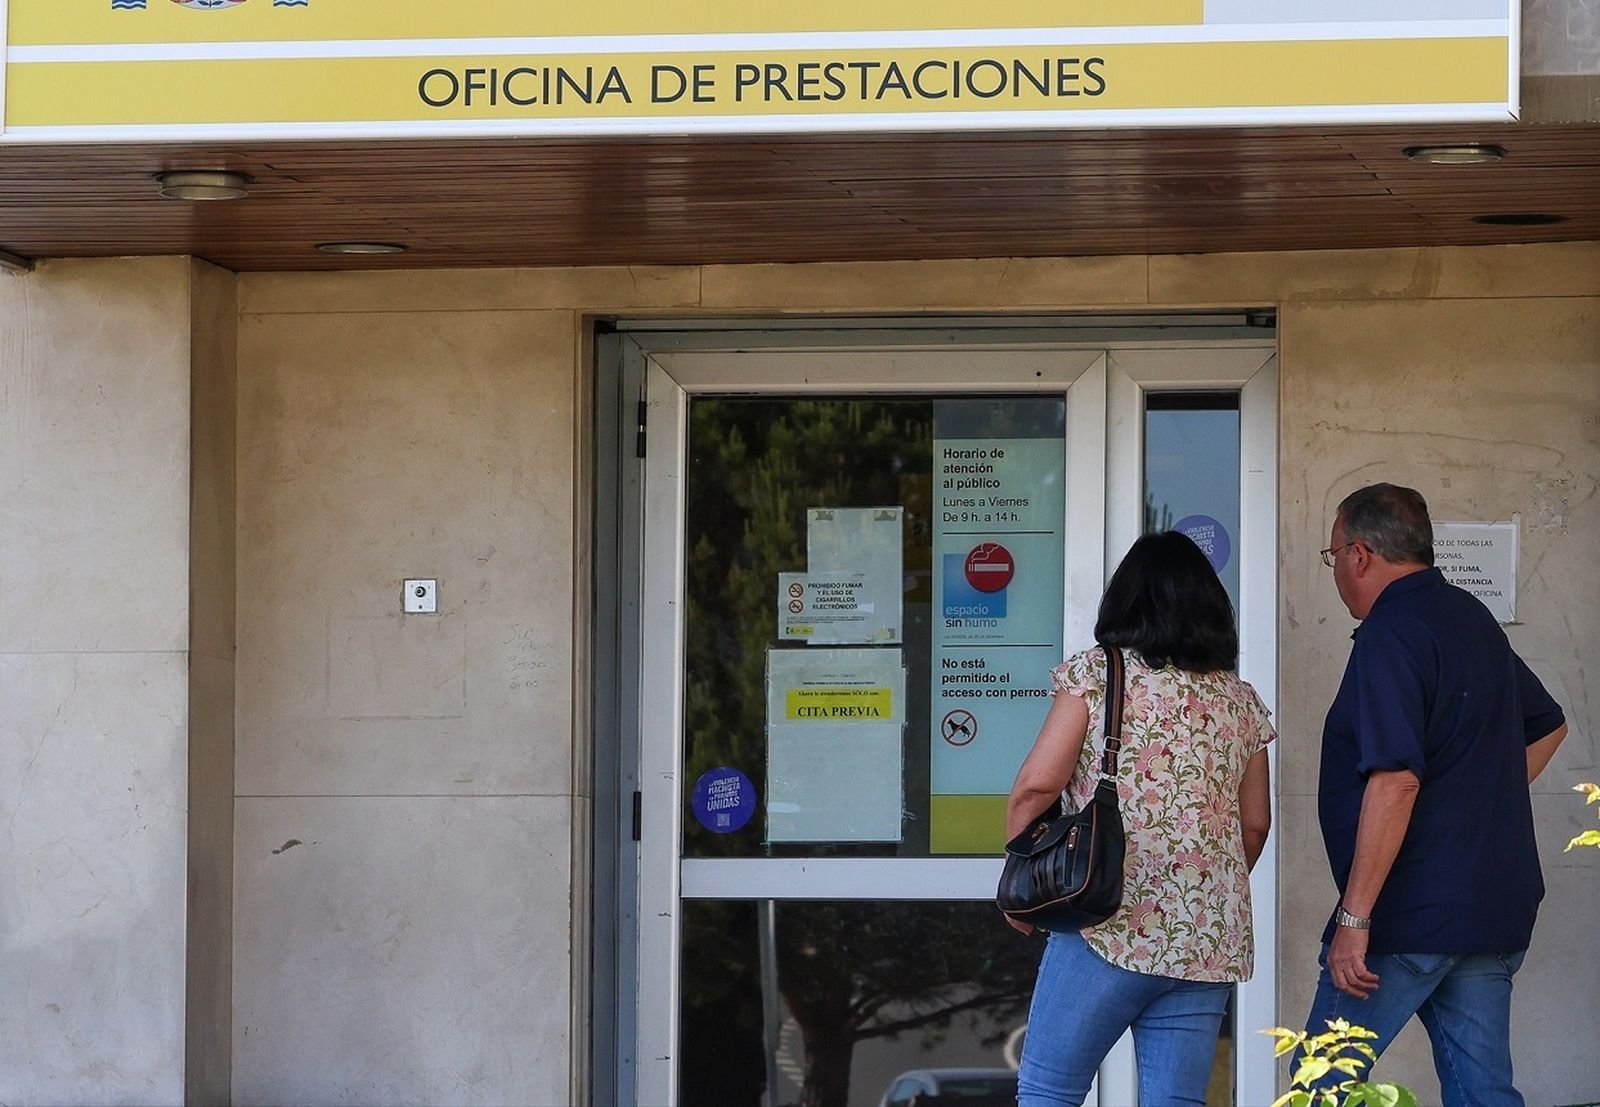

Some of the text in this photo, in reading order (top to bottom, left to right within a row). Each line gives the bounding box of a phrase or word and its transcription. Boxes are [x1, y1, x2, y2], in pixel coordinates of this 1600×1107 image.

[418, 57, 1106, 107] OFICINA DE PRESTACIONES
[943, 448, 1005, 459] Horario de
[943, 463, 993, 474] atención
[943, 477, 1001, 491] al público
[943, 496, 1029, 507] Lunes a Viernes
[943, 512, 1021, 522] De 9 h. a 14 h.
[812, 602, 858, 610] ELECTRÓNICOS
[945, 604, 989, 617] espacio
[945, 617, 998, 628] sin humo
[942, 657, 986, 669] No está
[941, 673, 1010, 685] permitido el
[942, 689, 1048, 699] acceso con perros
[797, 706, 880, 717] CITA PREVIA
[707, 796, 740, 811] UNIDAS
